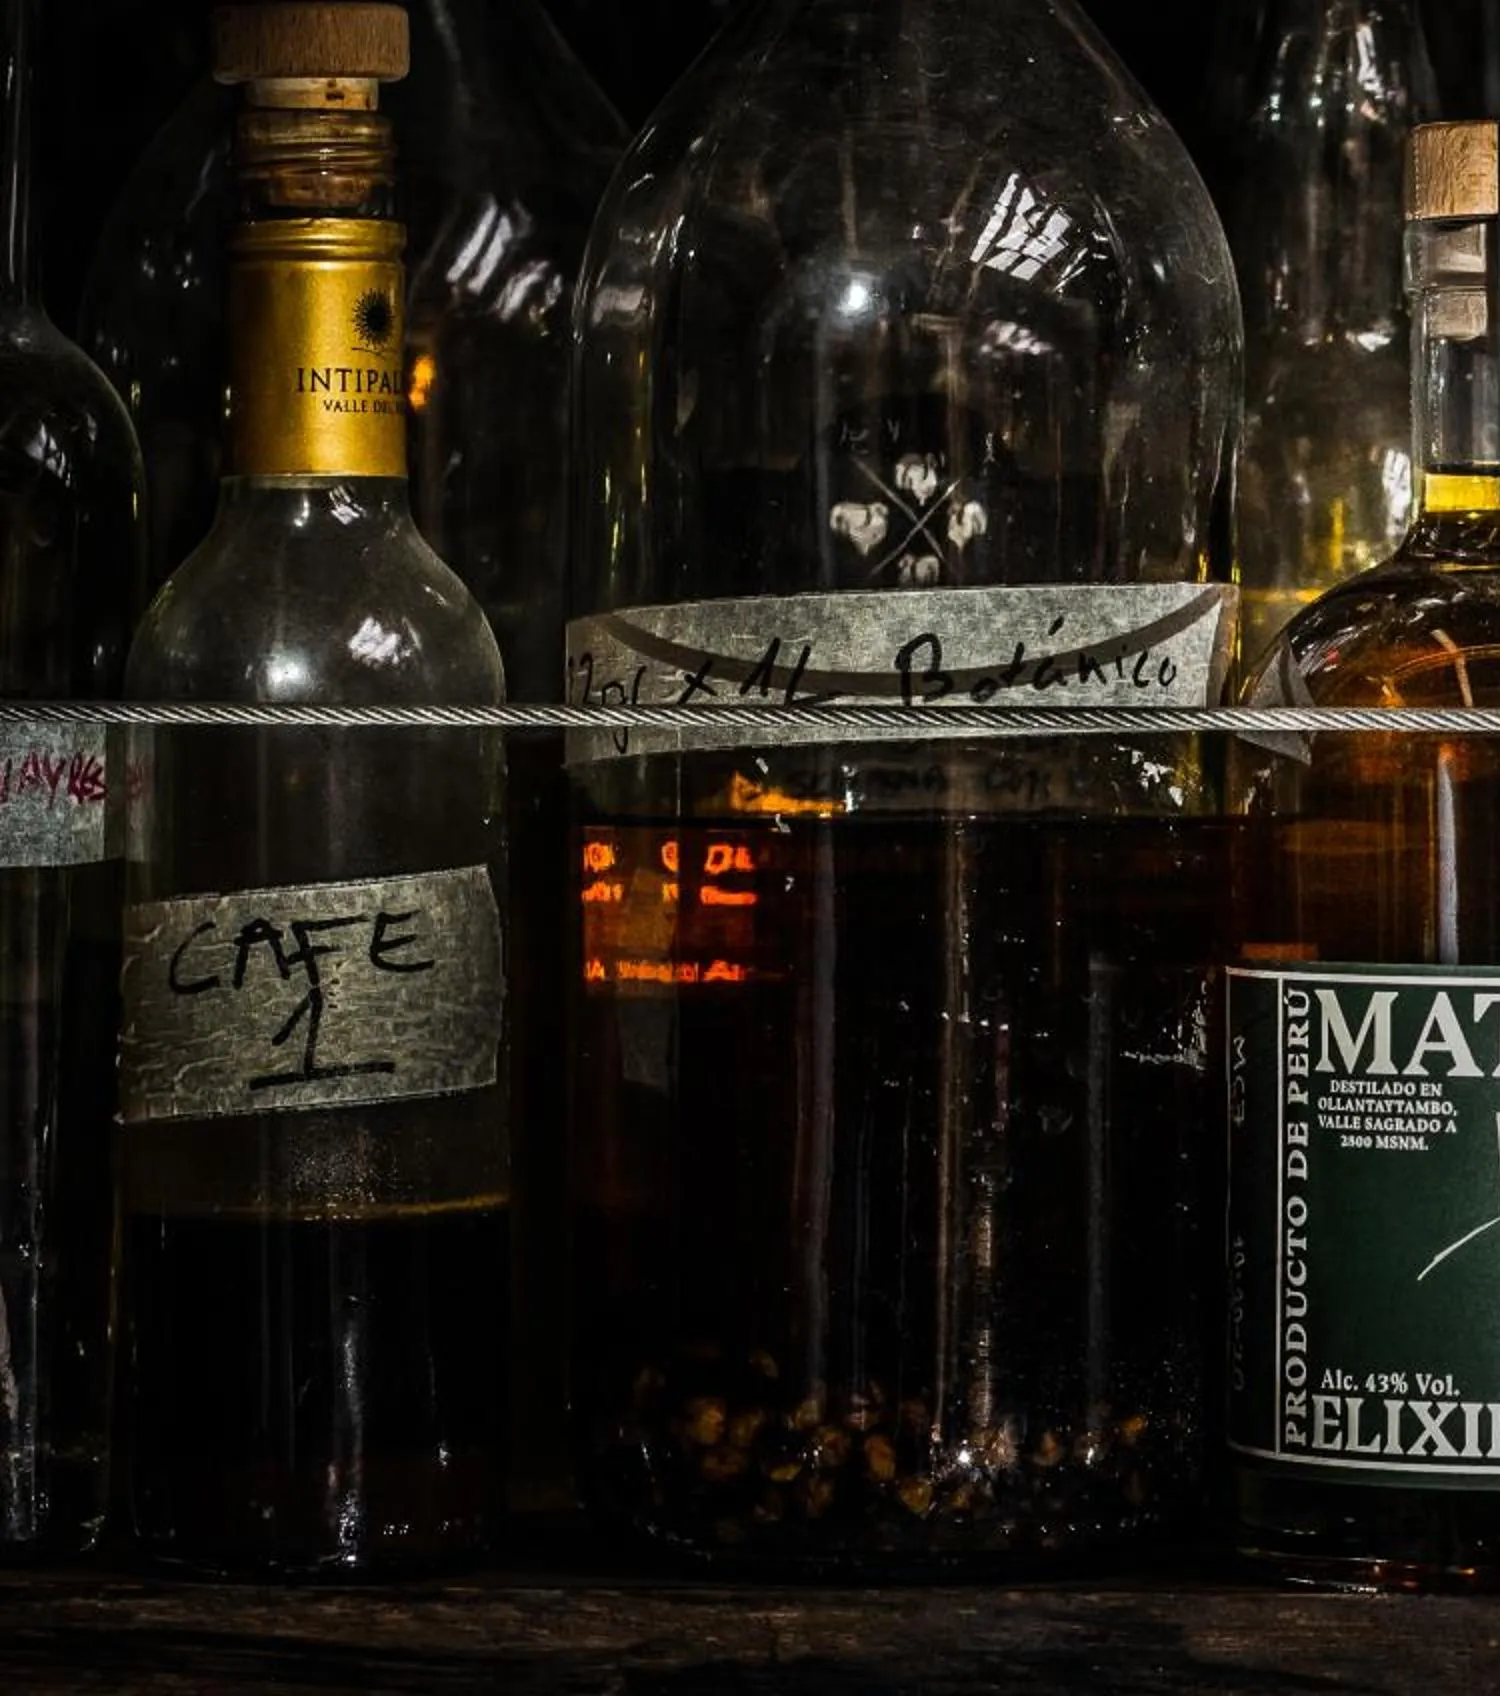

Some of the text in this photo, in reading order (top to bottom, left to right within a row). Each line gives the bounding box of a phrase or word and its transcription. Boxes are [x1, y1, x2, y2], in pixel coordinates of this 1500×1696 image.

[323, 399, 368, 414] VALLE
[1330, 1080, 1443, 1097] DESTILADO EN
[1317, 1113, 1457, 1134] VALLE SAGRADO A
[1284, 988, 1310, 1446] PRODUCTO DE PERÚ
[1321, 1368, 1461, 1397] Alc. 43% Vol.
